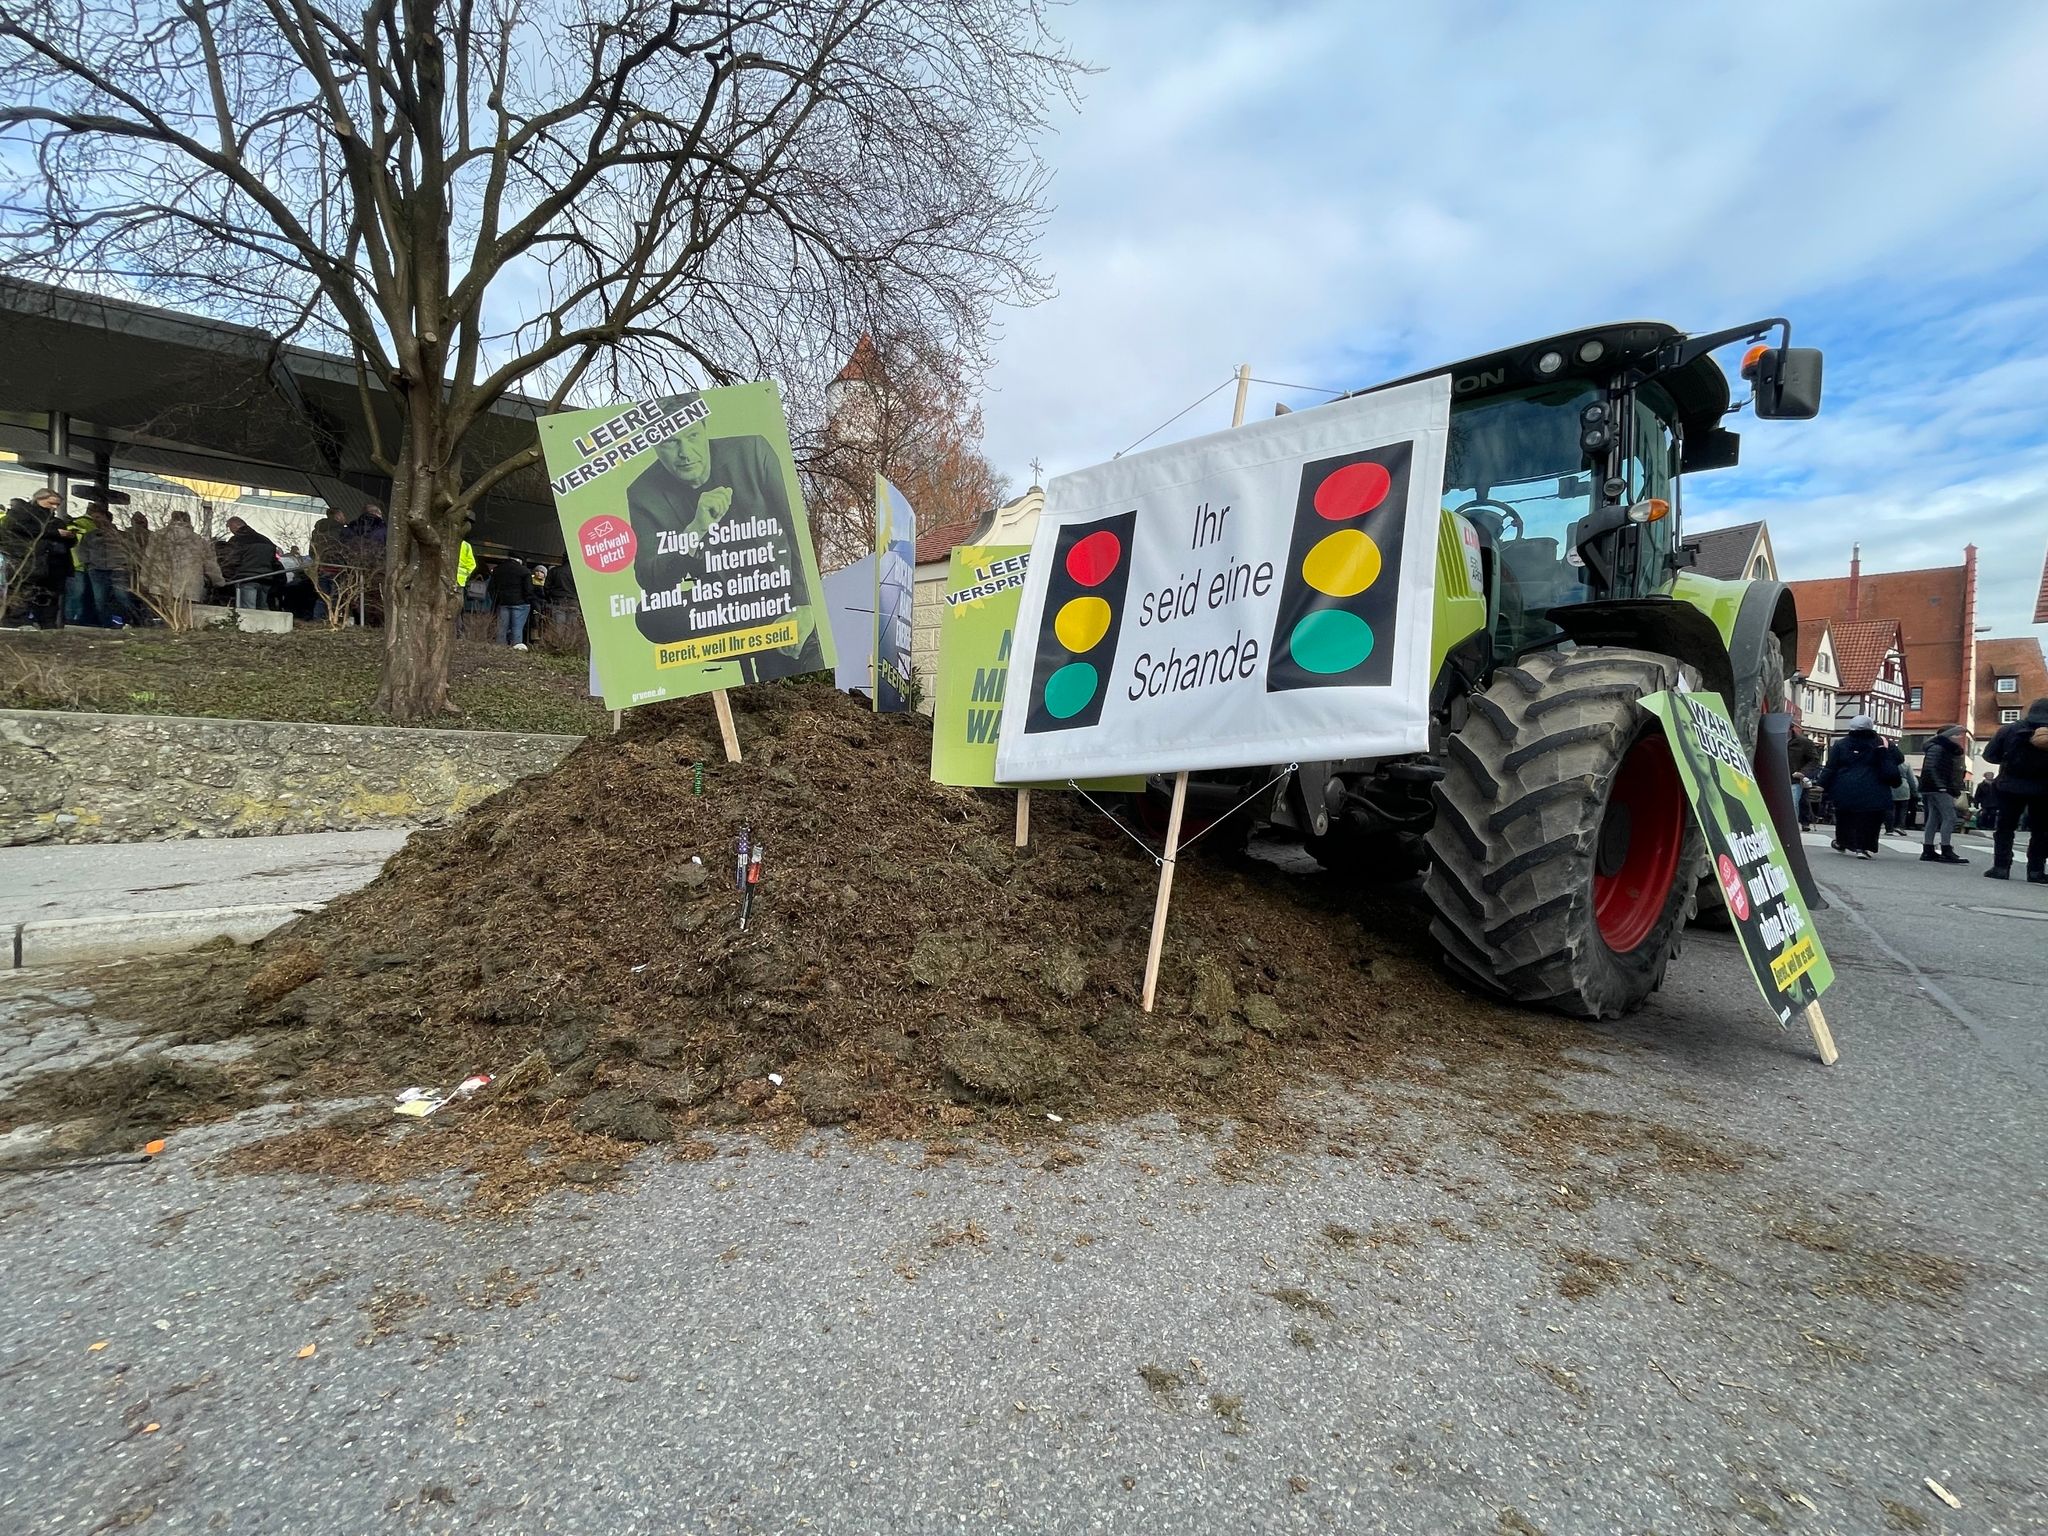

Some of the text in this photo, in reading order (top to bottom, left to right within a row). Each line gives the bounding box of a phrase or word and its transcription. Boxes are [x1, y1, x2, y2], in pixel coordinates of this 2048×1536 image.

[550, 399, 710, 496] VERSPRECHEN!
[574, 399, 662, 458] LEERE
[585, 531, 630, 557] Briefwahl
[656, 516, 784, 556] Züge, Schulen,
[1191, 502, 1231, 550] Ihr
[600, 546, 625, 568] jetzt!
[705, 542, 776, 573] Internet
[976, 553, 1031, 582] LEER
[609, 564, 791, 618] Ein Land, das einfach
[946, 571, 1027, 606] VERSPR
[1139, 555, 1274, 627] seid eine
[688, 592, 797, 631] funktioniert.
[660, 625, 794, 665] Bereit, weil Ihr es seid.
[971, 668, 1008, 703] MI
[1128, 629, 1259, 702] Schande
[1725, 822, 1775, 868] Wirtschaft
[1748, 866, 1771, 907] und
[1760, 912, 1785, 951] ohne
